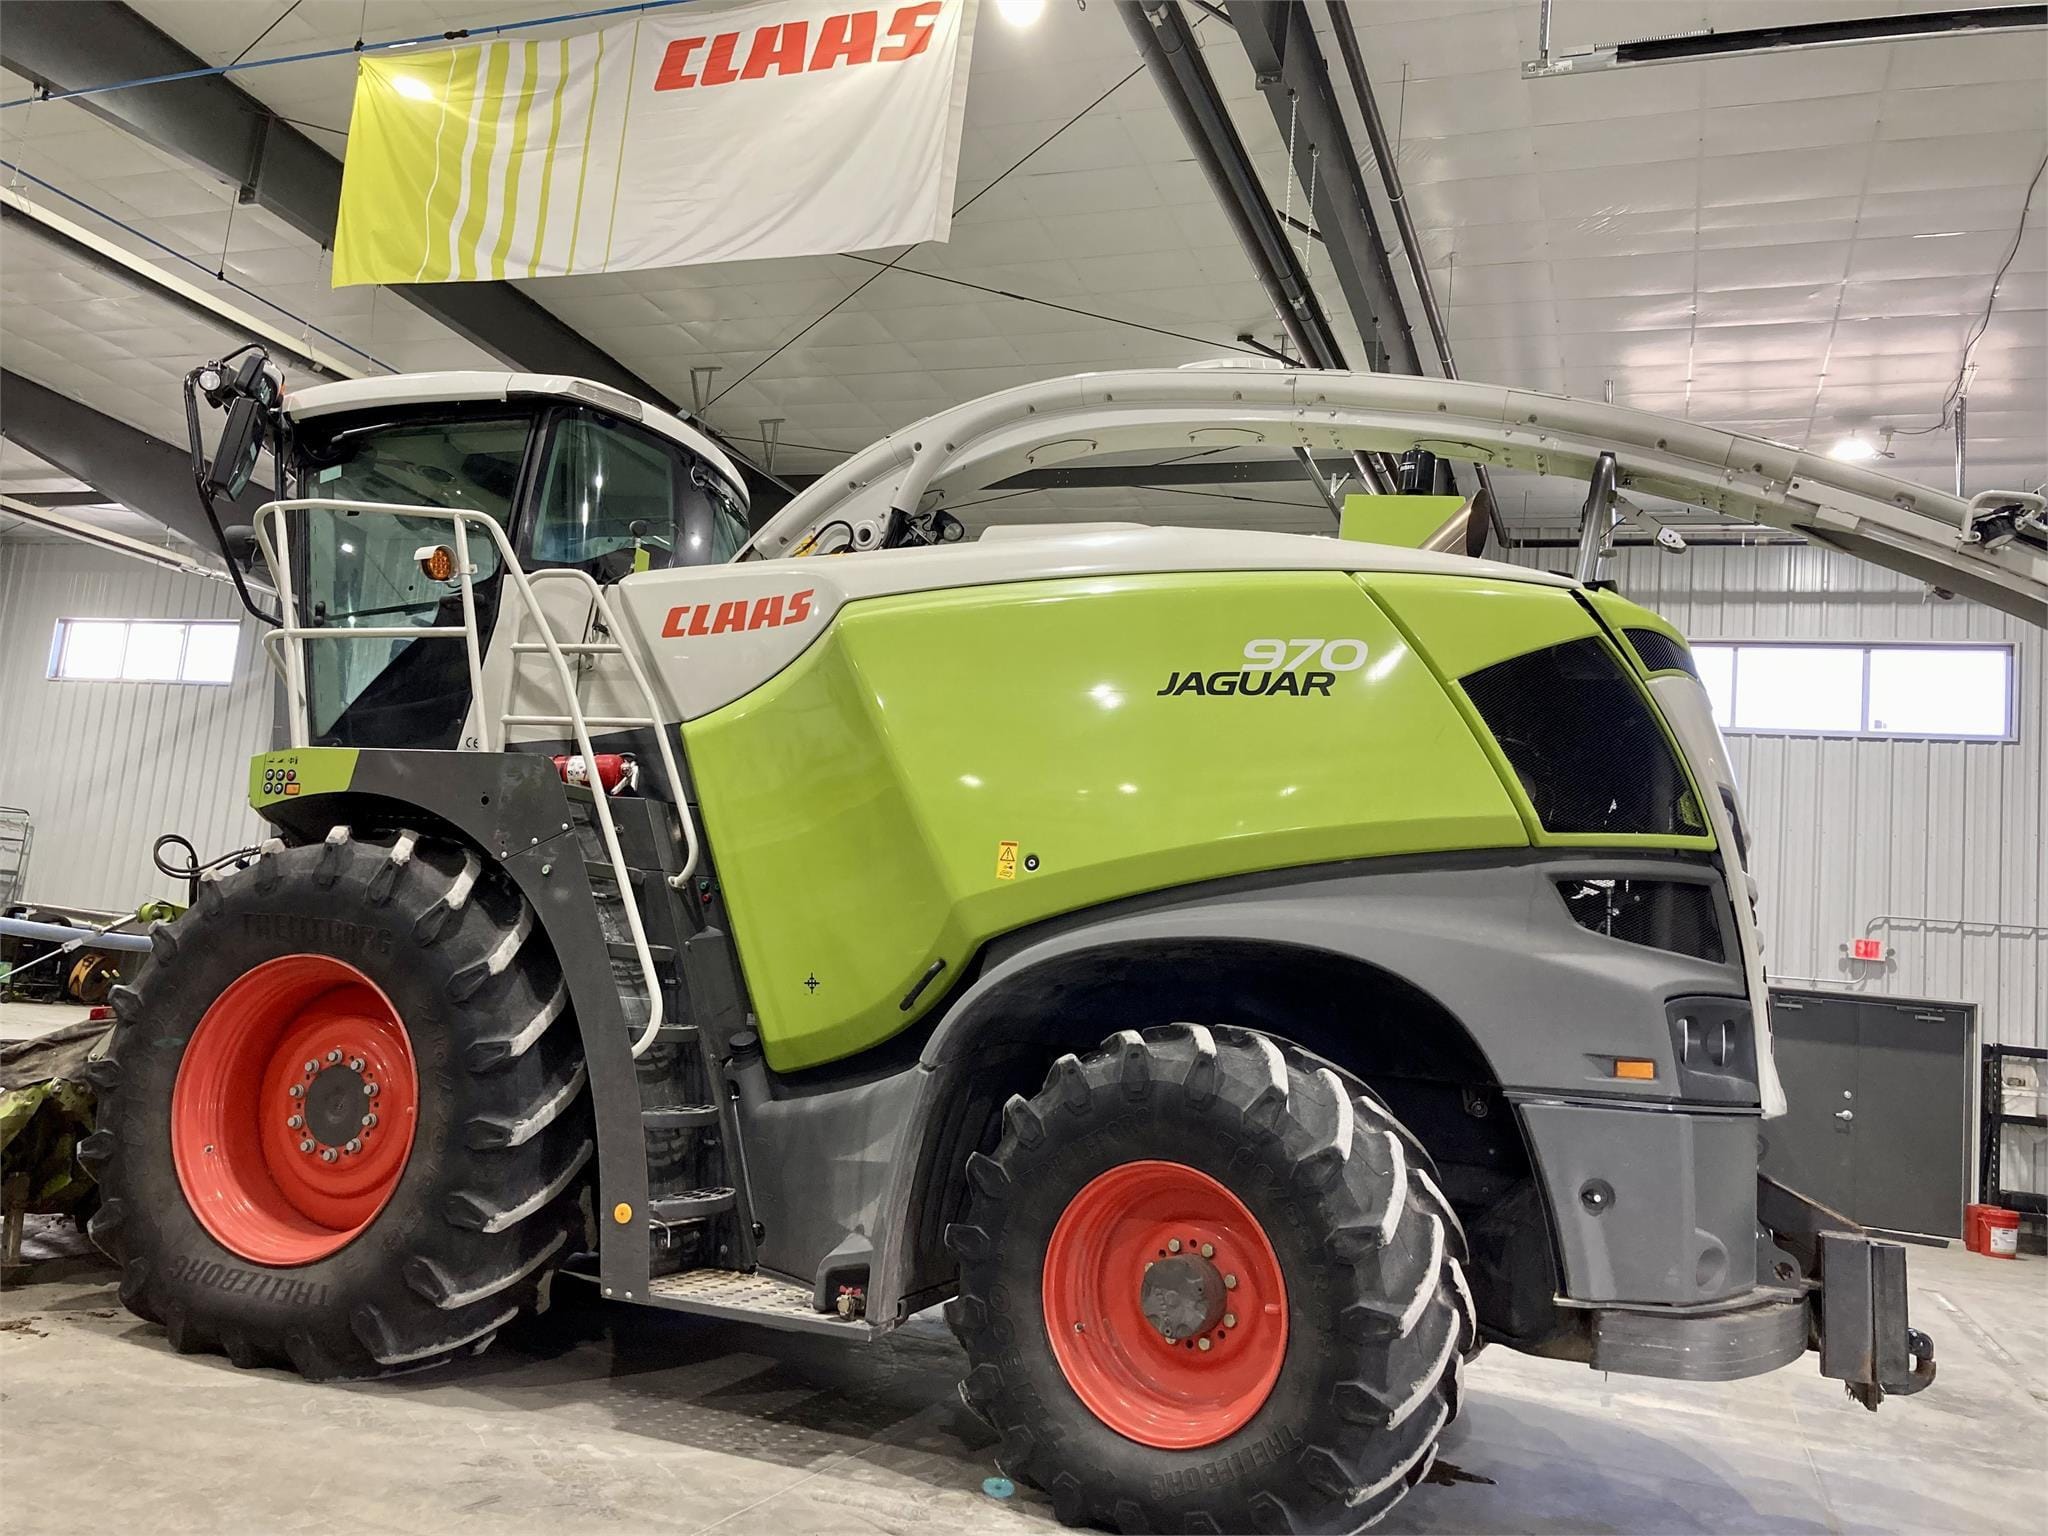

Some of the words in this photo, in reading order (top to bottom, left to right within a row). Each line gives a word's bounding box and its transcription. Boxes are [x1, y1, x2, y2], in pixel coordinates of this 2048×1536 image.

[654, 1, 942, 92] CLAAS
[662, 590, 814, 638] CLAAS
[1241, 638, 1369, 673] 970
[1157, 671, 1336, 697] JAGUAR
[1854, 939, 1881, 960] EXIT
[167, 1256, 330, 1306] TRELLEBORG
[1150, 1425, 1305, 1502] TRELLEBORG
